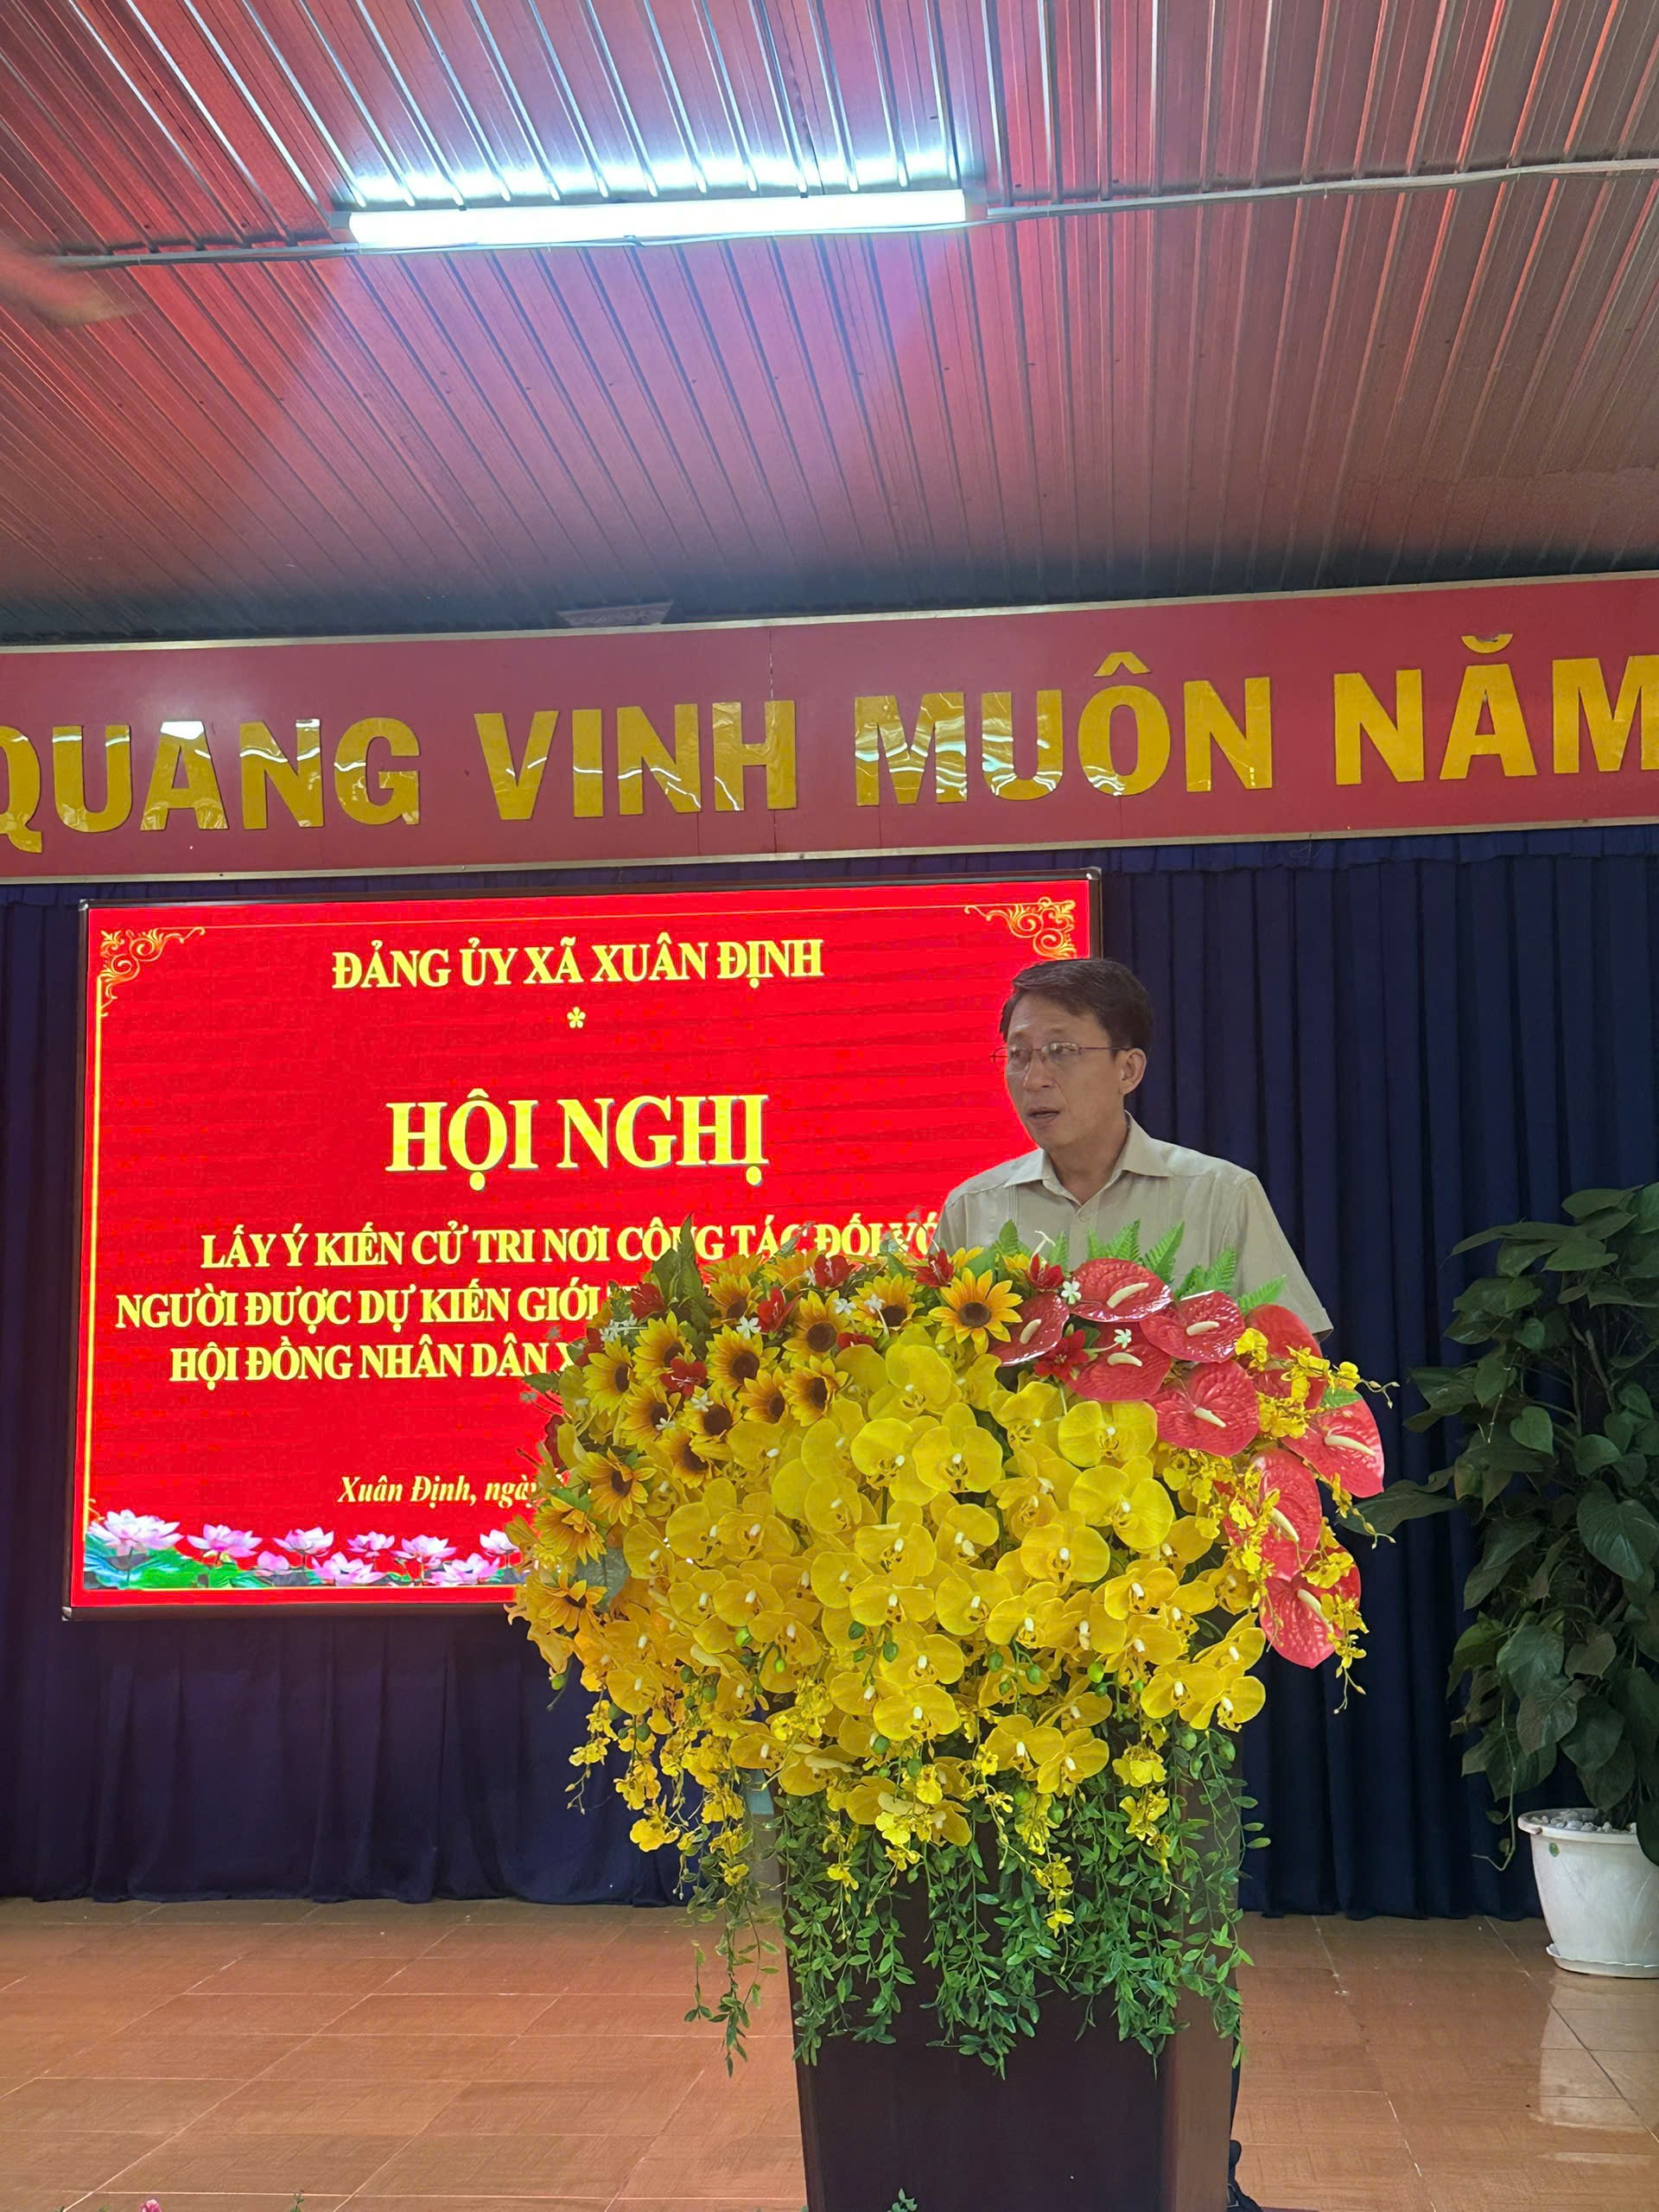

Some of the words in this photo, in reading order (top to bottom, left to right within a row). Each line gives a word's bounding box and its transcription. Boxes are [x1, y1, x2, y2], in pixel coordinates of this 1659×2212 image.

[474, 700, 796, 821] VINH
[854, 652, 1274, 806] MUÔN
[1333, 633, 1659, 785] NĂM
[332, 939, 450, 989] ĐẢNG
[459, 936, 518, 987] ỦY
[523, 936, 584, 985] XÃ
[590, 931, 709, 982] XUÂN
[716, 938, 825, 989] ĐỊNH
[385, 1088, 540, 1192] HỘI
[556, 1094, 770, 1187] NGHỊ
[200, 1224, 277, 1268] LẤY
[281, 1223, 309, 1267] Ý
[314, 1221, 406, 1267] KIẾN
[411, 1220, 470, 1265] CỬ
[473, 1227, 536, 1265] TRI
[542, 1224, 610, 1263] NƠI
[115, 1282, 239, 1329] NGƯỜI
[245, 1287, 352, 1334] ĐƯỢC
[358, 1283, 416, 1333] DỰ
[420, 1277, 512, 1323] KIẾN
[518, 1276, 601, 1322] GIỚI
[168, 1341, 239, 1390] HỘI
[245, 1335, 353, 1381] ĐỒNG
[359, 1334, 465, 1380] NHÂN
[470, 1332, 550, 1377] DÂN
[337, 1474, 404, 1503] Xuân
[410, 1474, 477, 1510] Định,
